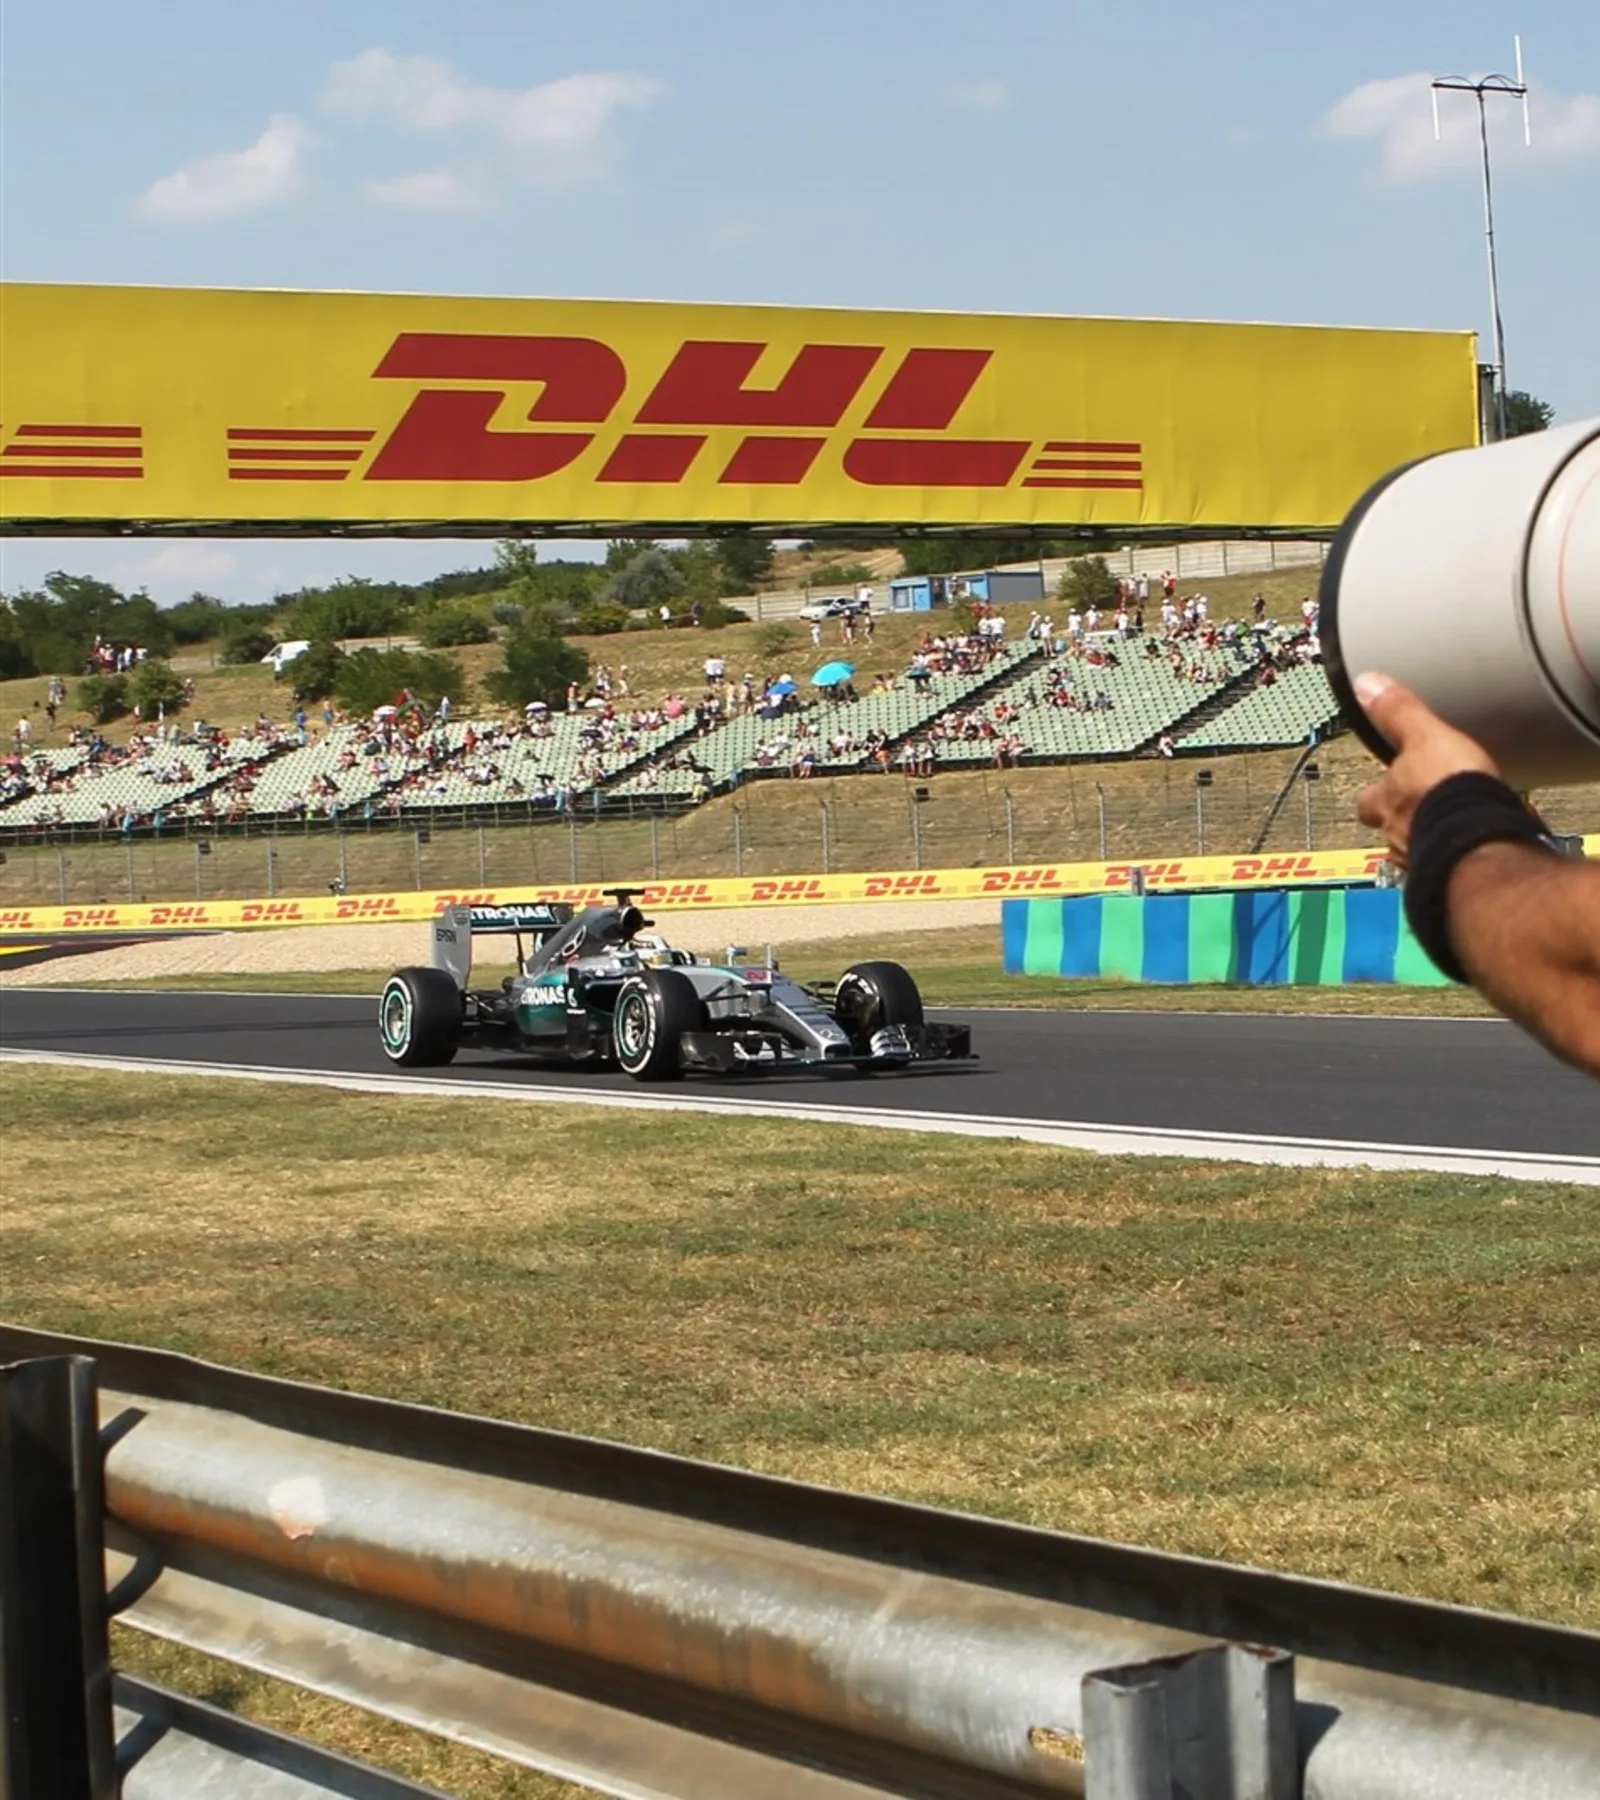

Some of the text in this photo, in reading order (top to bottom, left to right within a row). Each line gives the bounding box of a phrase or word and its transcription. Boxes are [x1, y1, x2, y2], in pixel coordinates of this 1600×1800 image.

[361, 332, 1033, 488] DHL
[1233, 857, 1317, 880] DHL
[752, 880, 825, 901] DHL
[865, 875, 941, 897] DHL
[983, 870, 1062, 892] DHL
[641, 884, 713, 904] DHL
[63, 910, 119, 927] DHL
[151, 907, 210, 925] DHL
[241, 903, 302, 922] DHL
[337, 899, 399, 918] DHL
[470, 904, 550, 921] TRONAS
